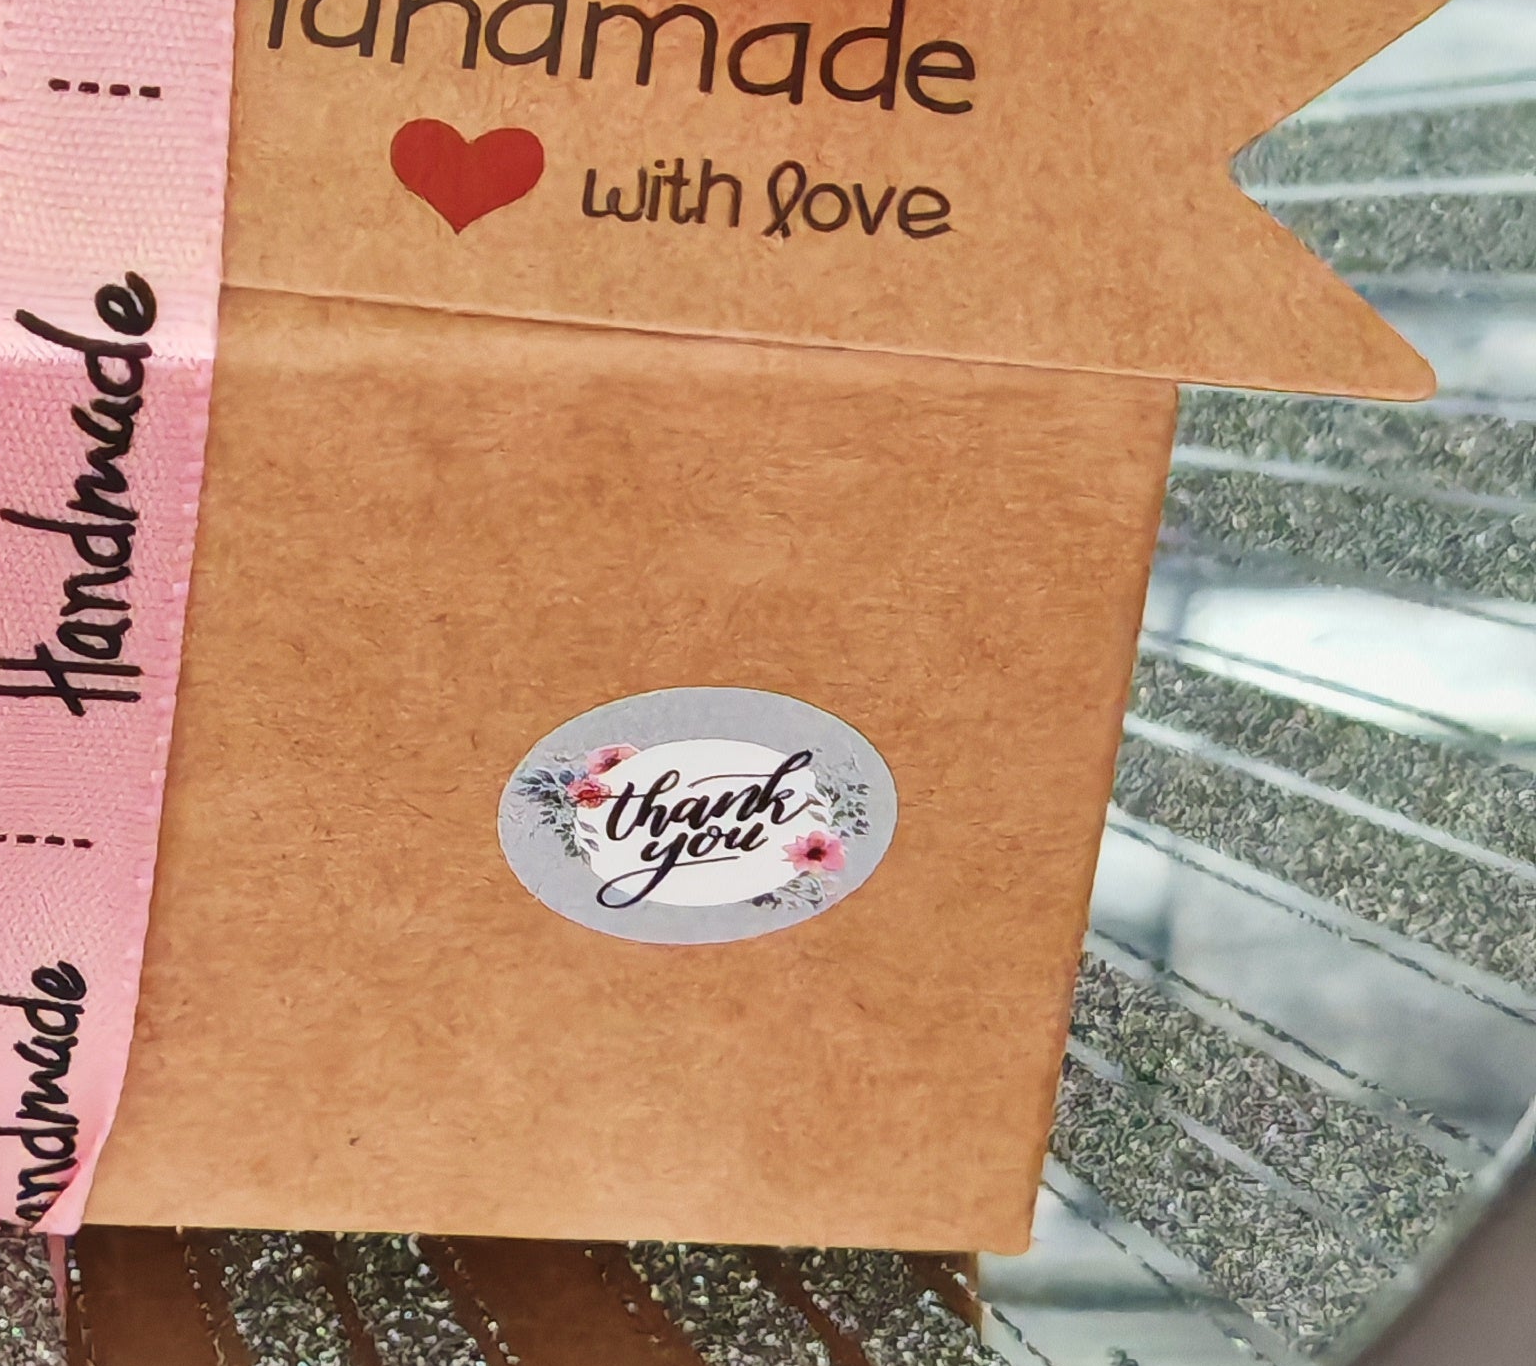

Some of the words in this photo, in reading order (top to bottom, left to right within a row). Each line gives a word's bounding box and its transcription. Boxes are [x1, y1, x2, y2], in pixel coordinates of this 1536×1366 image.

[581, 158, 743, 229] with
[765, 160, 953, 241] love
[576, 748, 814, 842] thank
[596, 820, 768, 909] you
